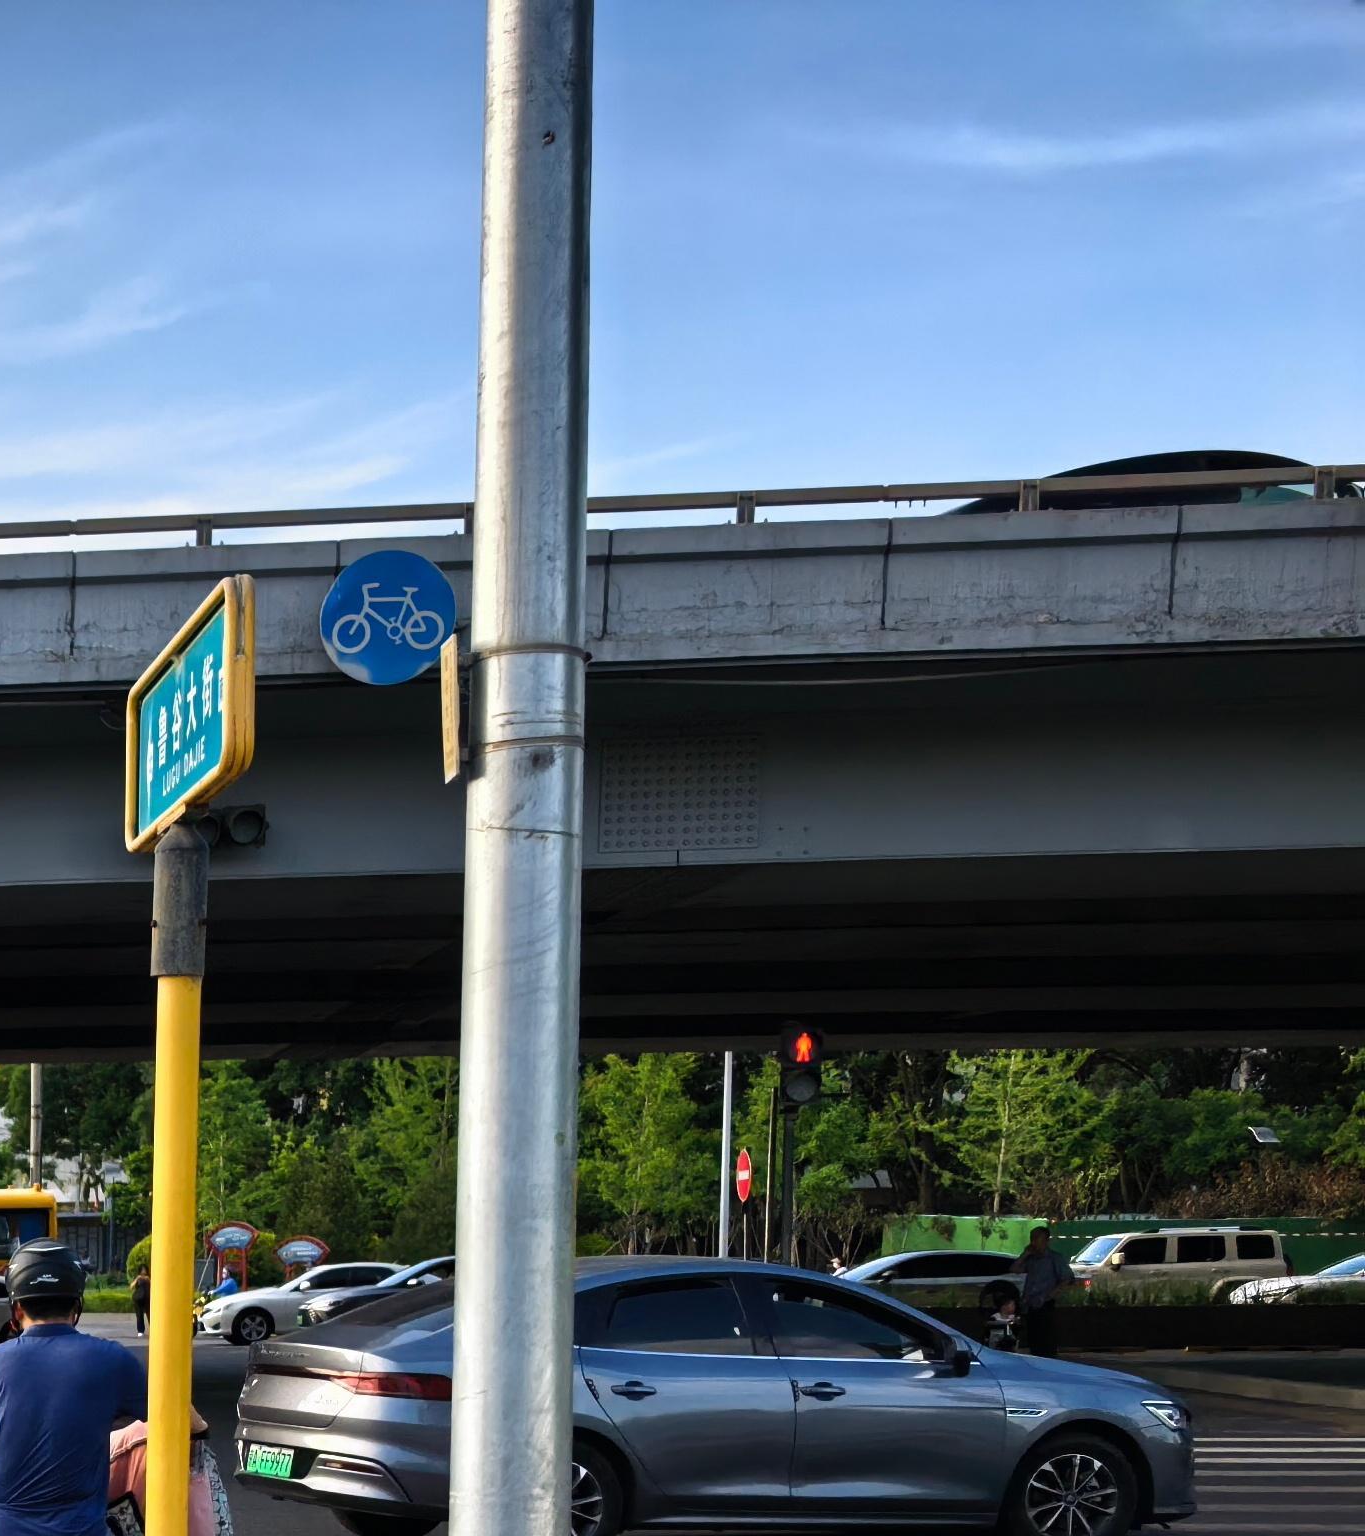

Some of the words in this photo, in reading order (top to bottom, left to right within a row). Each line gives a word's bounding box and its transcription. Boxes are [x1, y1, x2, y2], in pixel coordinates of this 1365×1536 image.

[158, 653, 213, 769] 鲁谷大街
[162, 764, 181, 797] LUGU
[183, 735, 206, 777] DAJIE
